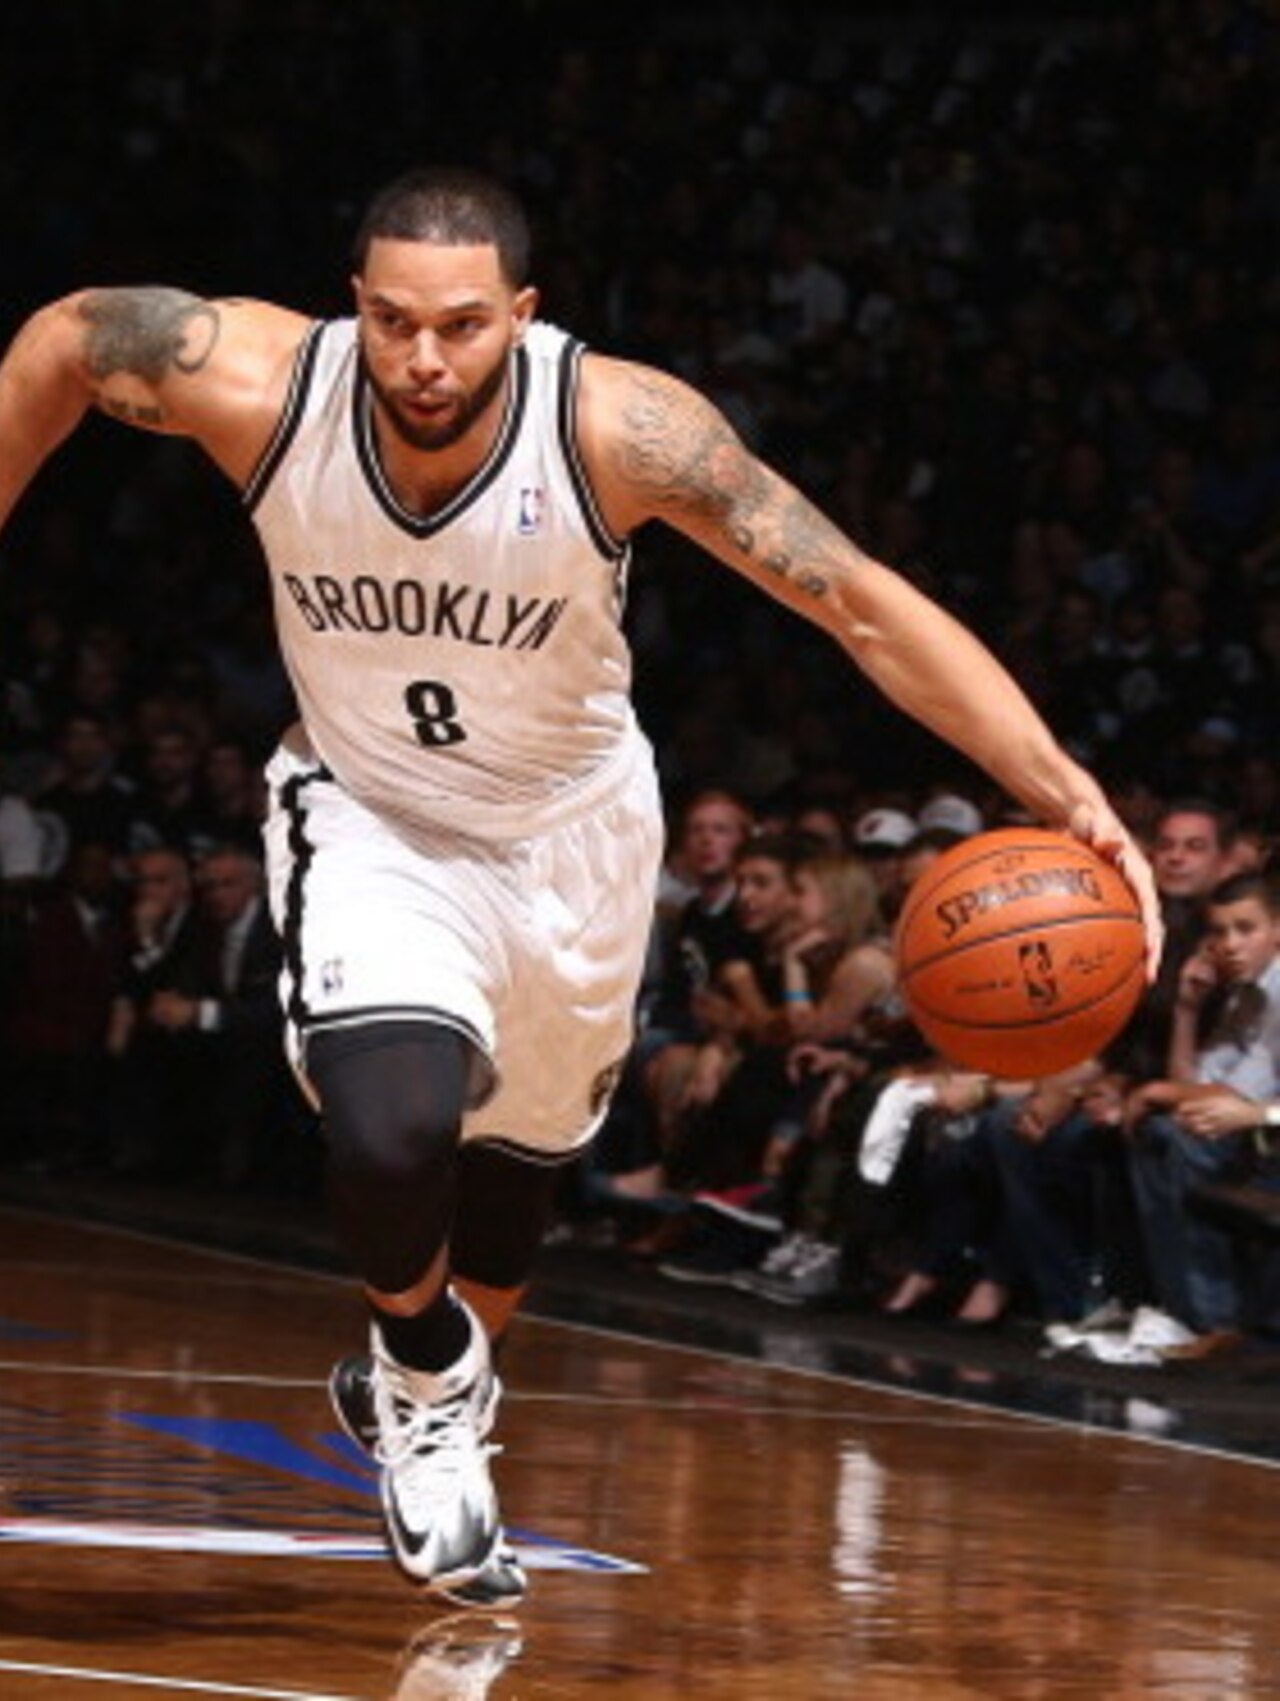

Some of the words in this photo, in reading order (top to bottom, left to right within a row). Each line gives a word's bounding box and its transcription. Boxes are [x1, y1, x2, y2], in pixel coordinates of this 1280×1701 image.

[282, 573, 568, 650] BROOKLYN
[404, 680, 466, 746] 8
[936, 868, 1102, 939] SPALDING
